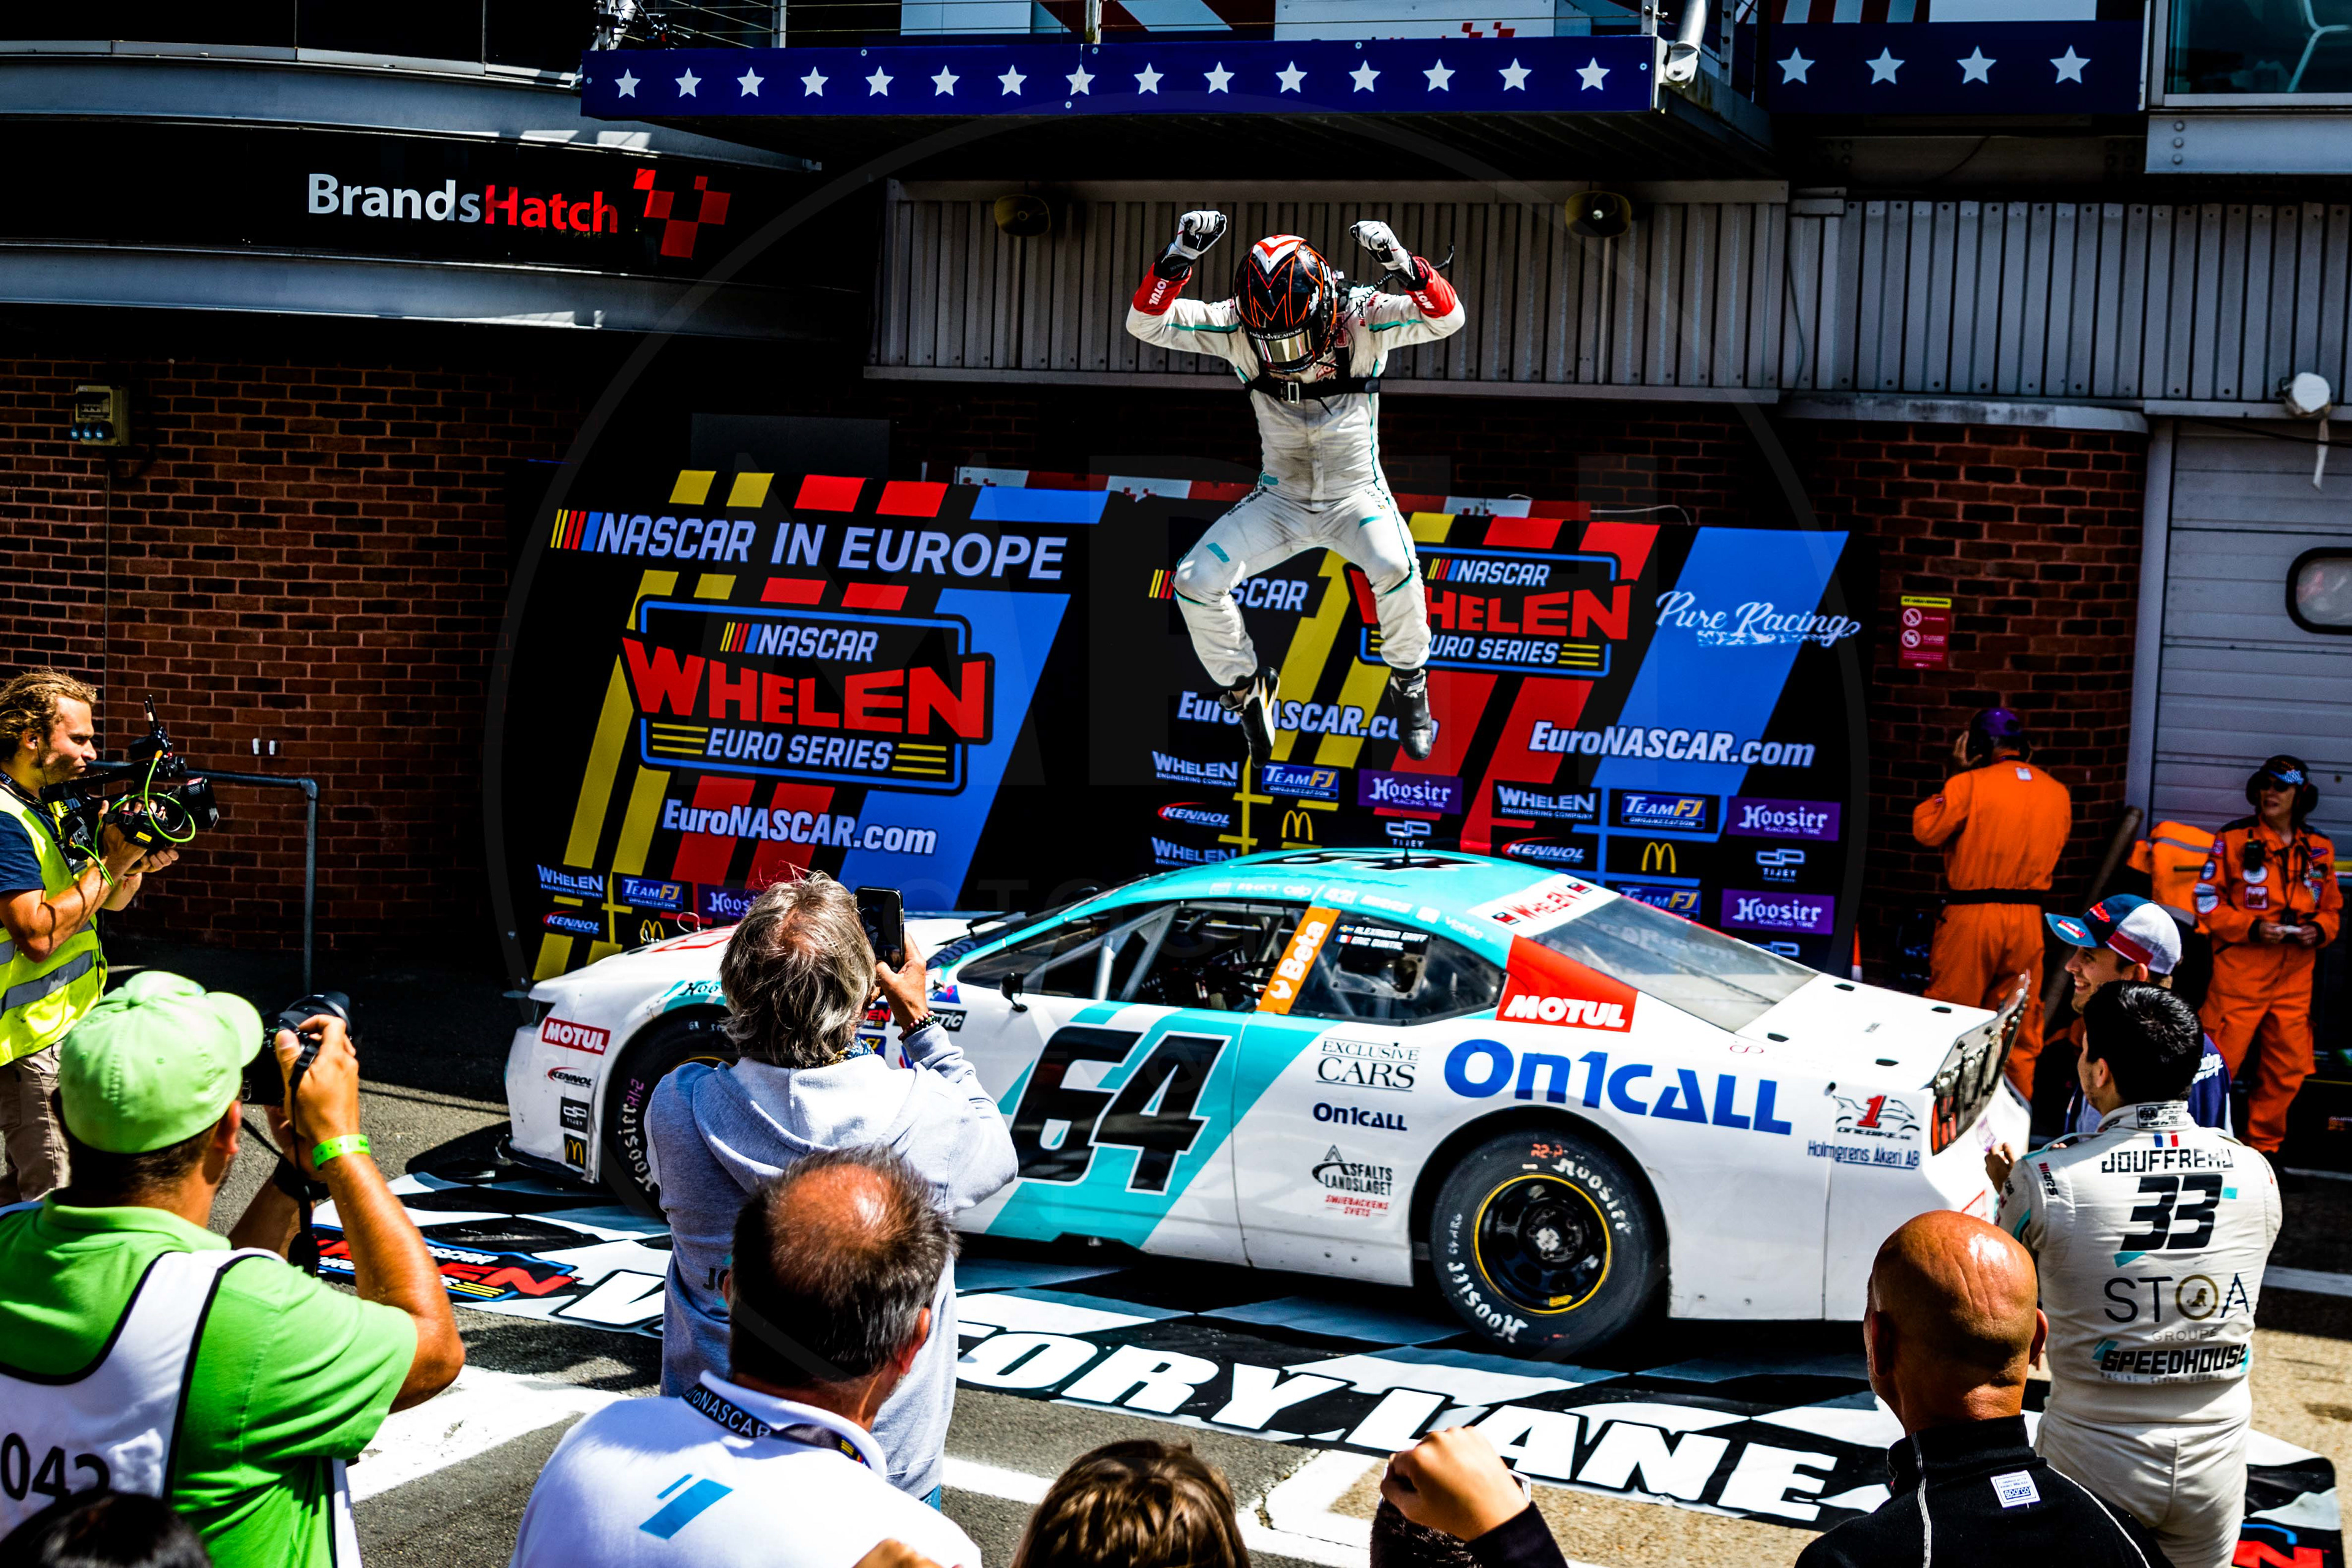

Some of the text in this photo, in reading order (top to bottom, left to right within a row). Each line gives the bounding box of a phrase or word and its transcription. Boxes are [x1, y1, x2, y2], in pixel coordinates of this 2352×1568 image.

[308, 173, 617, 234] BrandsHatch
[1148, 278, 1170, 306] OTUL
[597, 512, 1068, 579] NASCAR IN EUROPE
[1456, 559, 1550, 587] NASCAR
[1230, 578, 1309, 611] SCAR
[1656, 590, 1861, 648] Pure Racing
[758, 624, 879, 663] NASCAR
[1477, 638, 1560, 663] SERIES
[622, 636, 987, 739] WHELEN
[706, 728, 894, 771] EURO SERIES
[1528, 721, 1815, 767] EuroNASCAR.com
[1152, 750, 1238, 780] WHELEN
[1368, 777, 1452, 802] Hoosier
[1497, 785, 1596, 812] WHELEN
[662, 799, 937, 855] EuroNASCAR.com
[1162, 807, 1230, 824] KENNOL
[1738, 805, 1828, 829] Hoosier
[1152, 837, 1237, 864] WHELEN
[1507, 843, 1585, 859] KENNOL
[537, 864, 603, 892] WHELEN
[547, 914, 600, 932] KENNOL
[1732, 897, 1823, 922] Hoosier
[1278, 921, 1328, 981] Beta
[1504, 995, 1626, 1028] MOTUL
[545, 1022, 605, 1051] MOTUL
[1322, 1041, 1420, 1061] EXCLUSIVE
[551, 1069, 594, 1087] KENNOL
[1317, 1057, 1415, 1088] CARS
[1017, 1025, 1231, 1194] 64
[1808, 1139, 1870, 1164] Holmgrens
[1905, 1151, 1921, 1167] AB
[1325, 1174, 1392, 1195] LANDSLAGET
[2119, 1174, 2222, 1251] 33
[1446, 1261, 1529, 1344] Hoosier
[2100, 1343, 2247, 1375] SPEEDHOUSE
[1345, 1388, 1837, 1521] LANE
[2003, 1487, 2030, 1498] sparco
